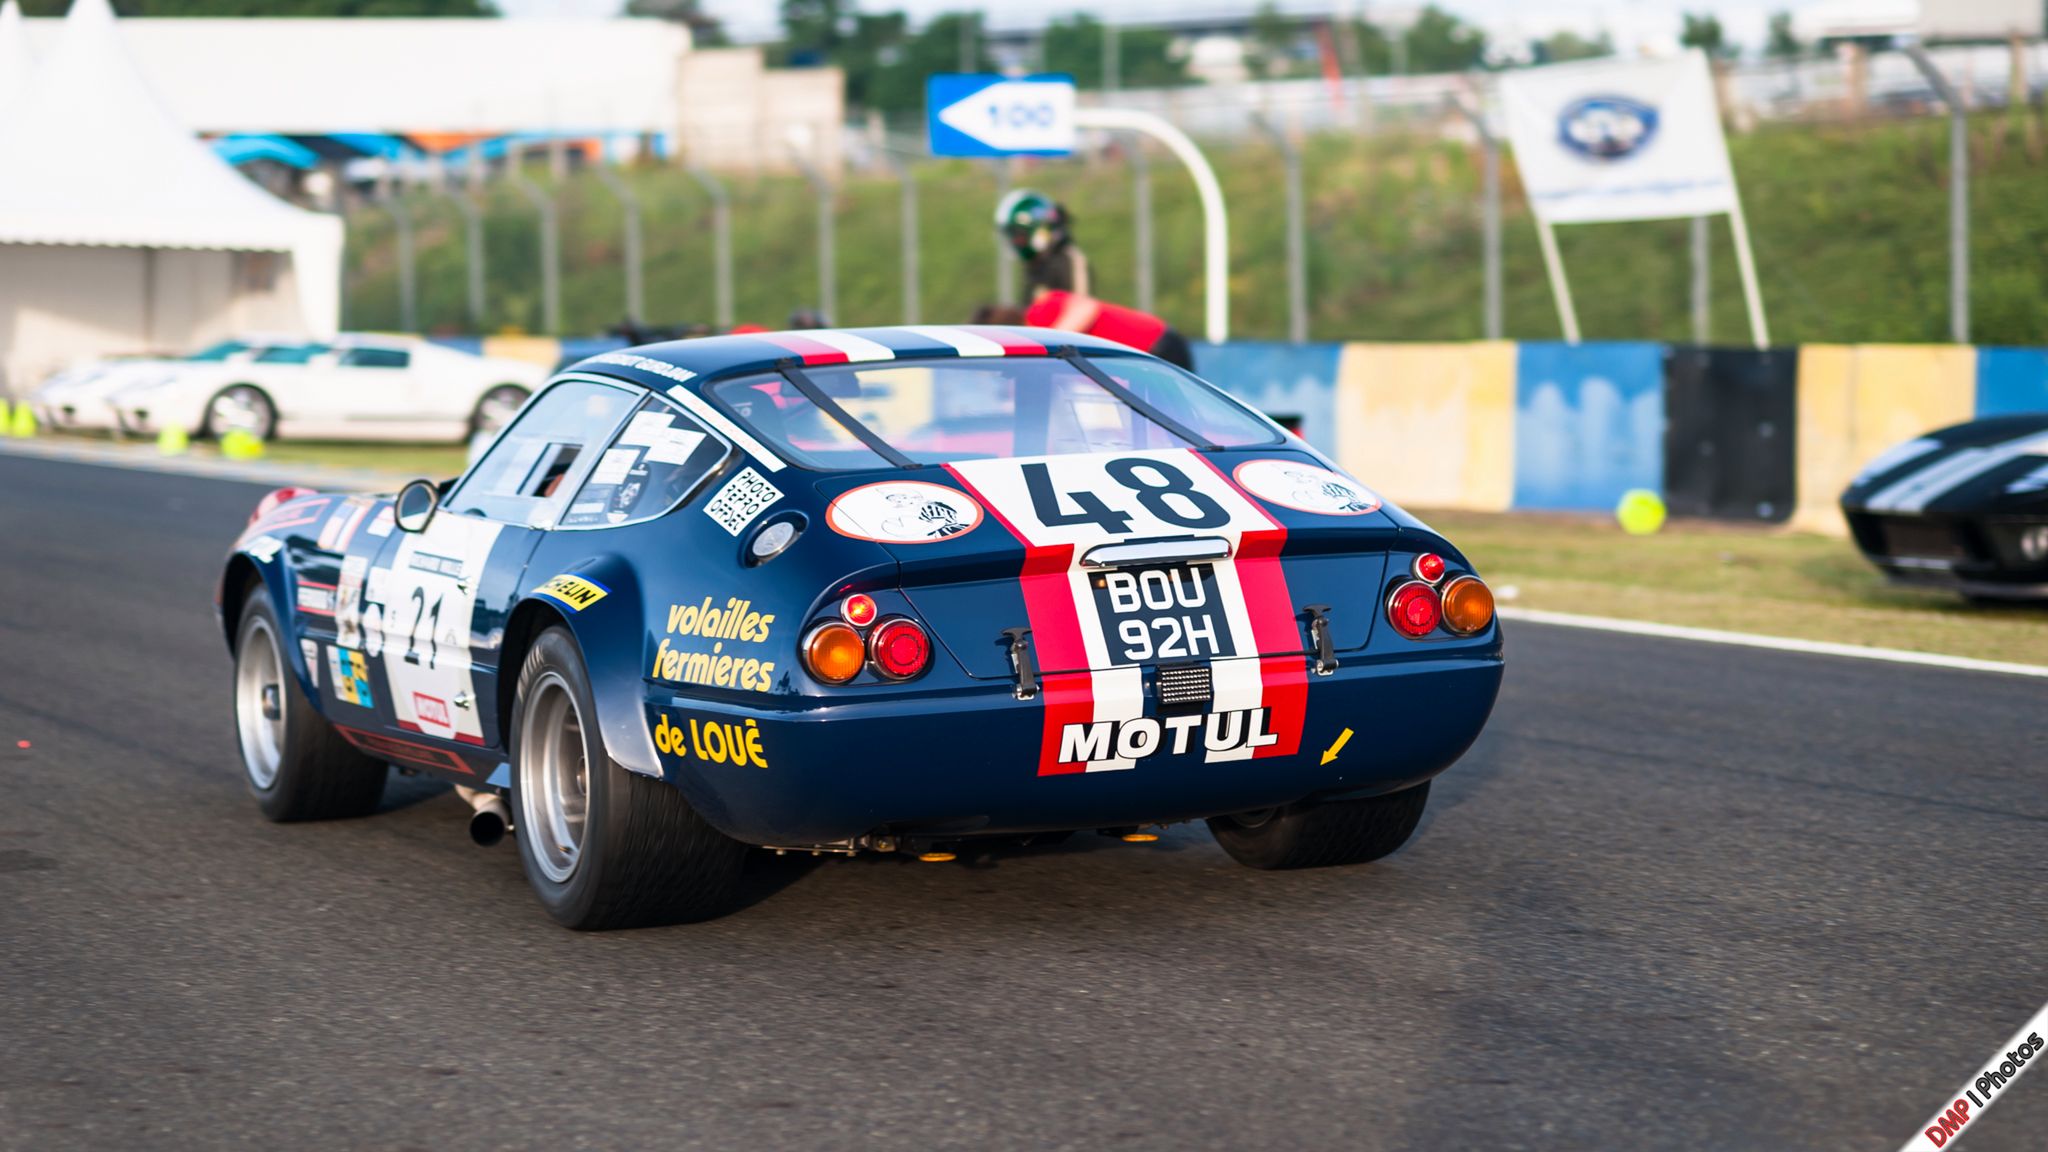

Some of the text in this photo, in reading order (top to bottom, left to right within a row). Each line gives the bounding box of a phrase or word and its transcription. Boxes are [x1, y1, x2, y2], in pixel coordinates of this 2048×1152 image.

[724, 484, 759, 515] REPRO
[738, 472, 776, 503] PHOTO
[1020, 458, 1231, 534] 48
[1105, 567, 1206, 613] BOU
[404, 586, 443, 670] 21
[666, 596, 775, 643] volailles
[1118, 614, 1220, 660] 92H
[652, 638, 775, 692] fermieres
[655, 713, 687, 757] de
[1058, 707, 1279, 763] MOTUL
